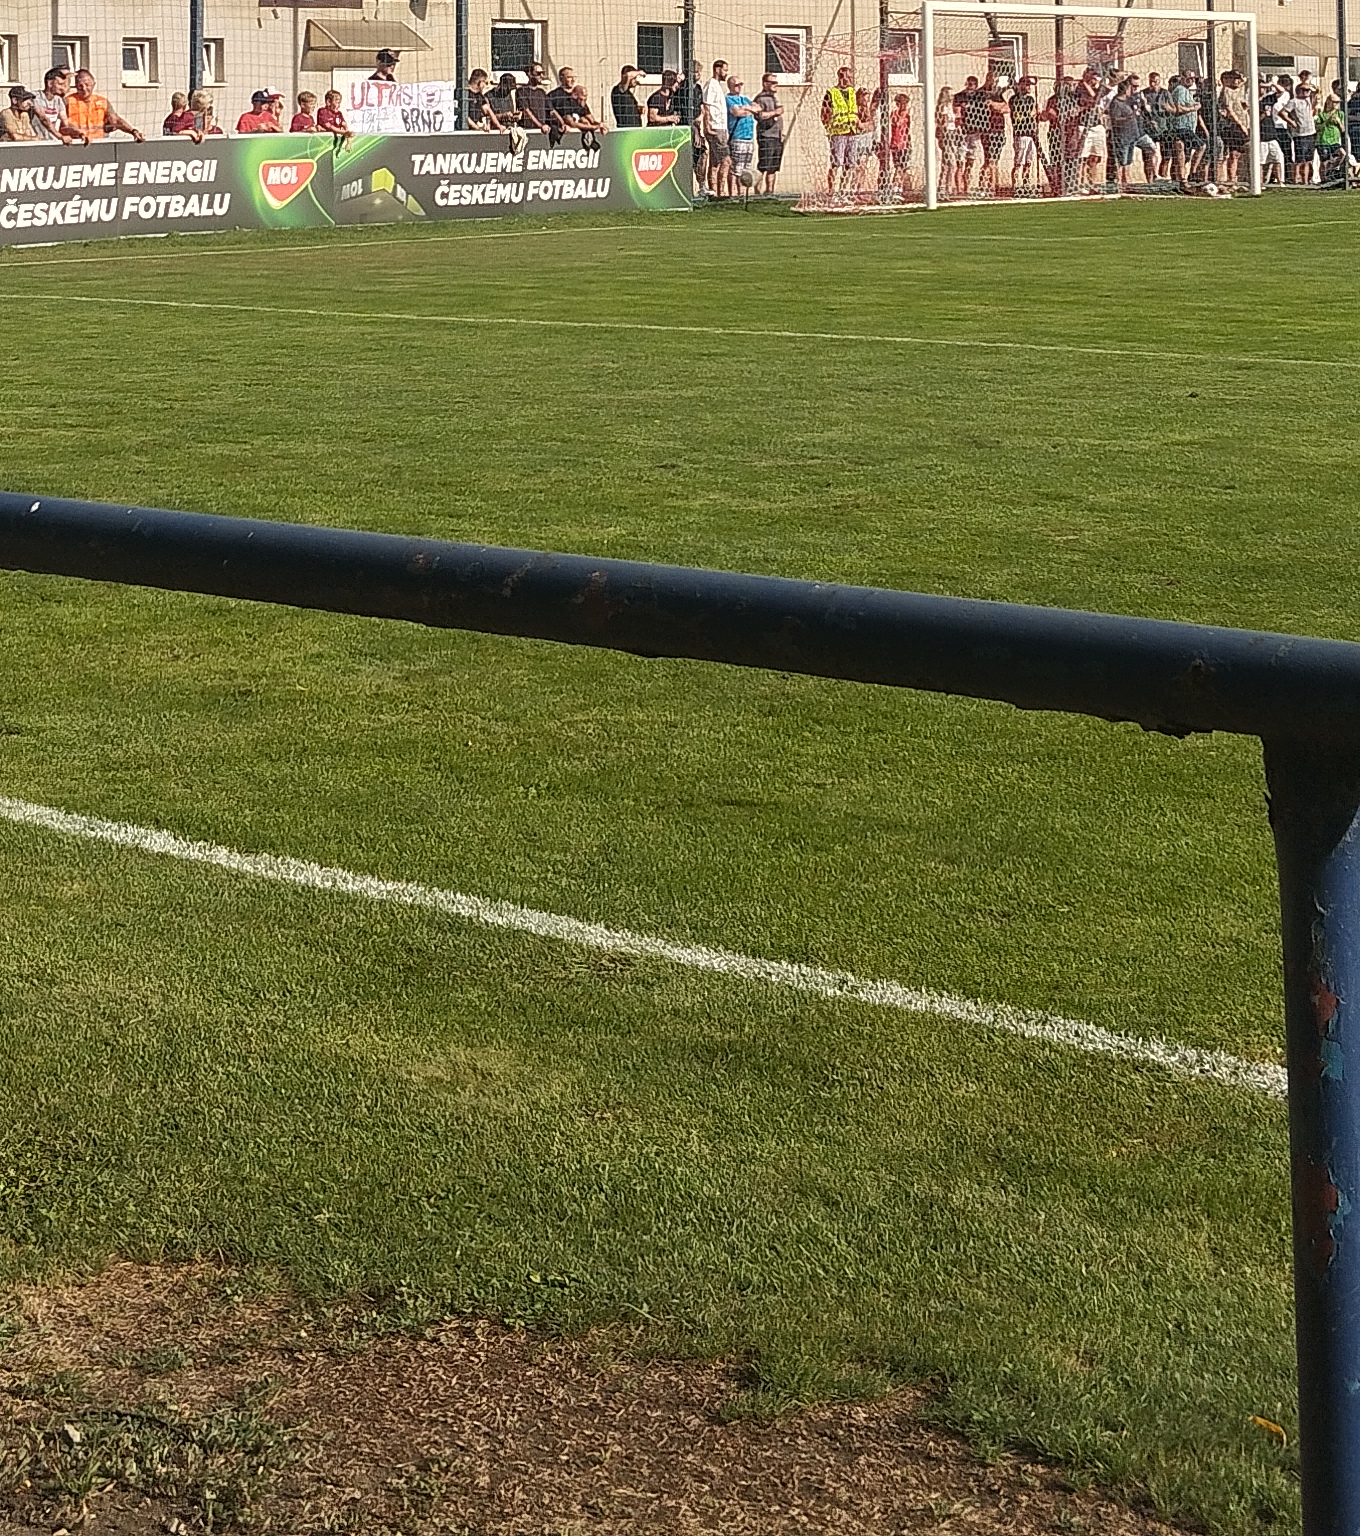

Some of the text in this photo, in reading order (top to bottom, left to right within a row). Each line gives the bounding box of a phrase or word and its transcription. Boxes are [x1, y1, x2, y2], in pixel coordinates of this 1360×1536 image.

[351, 81, 413, 109] ULTRAS
[401, 107, 444, 132] BRNO
[121, 158, 219, 186] ENERGII
[266, 165, 299, 185] MOL
[411, 148, 601, 176] TANKUJEME ENERGII
[637, 154, 664, 172] MOL
[341, 178, 364, 201] MOL
[434, 178, 525, 207] ČESKÉMU
[526, 177, 611, 202] FOTBALU
[0, 194, 120, 230] ČESKÉMU
[122, 193, 231, 220] FOTBALU
